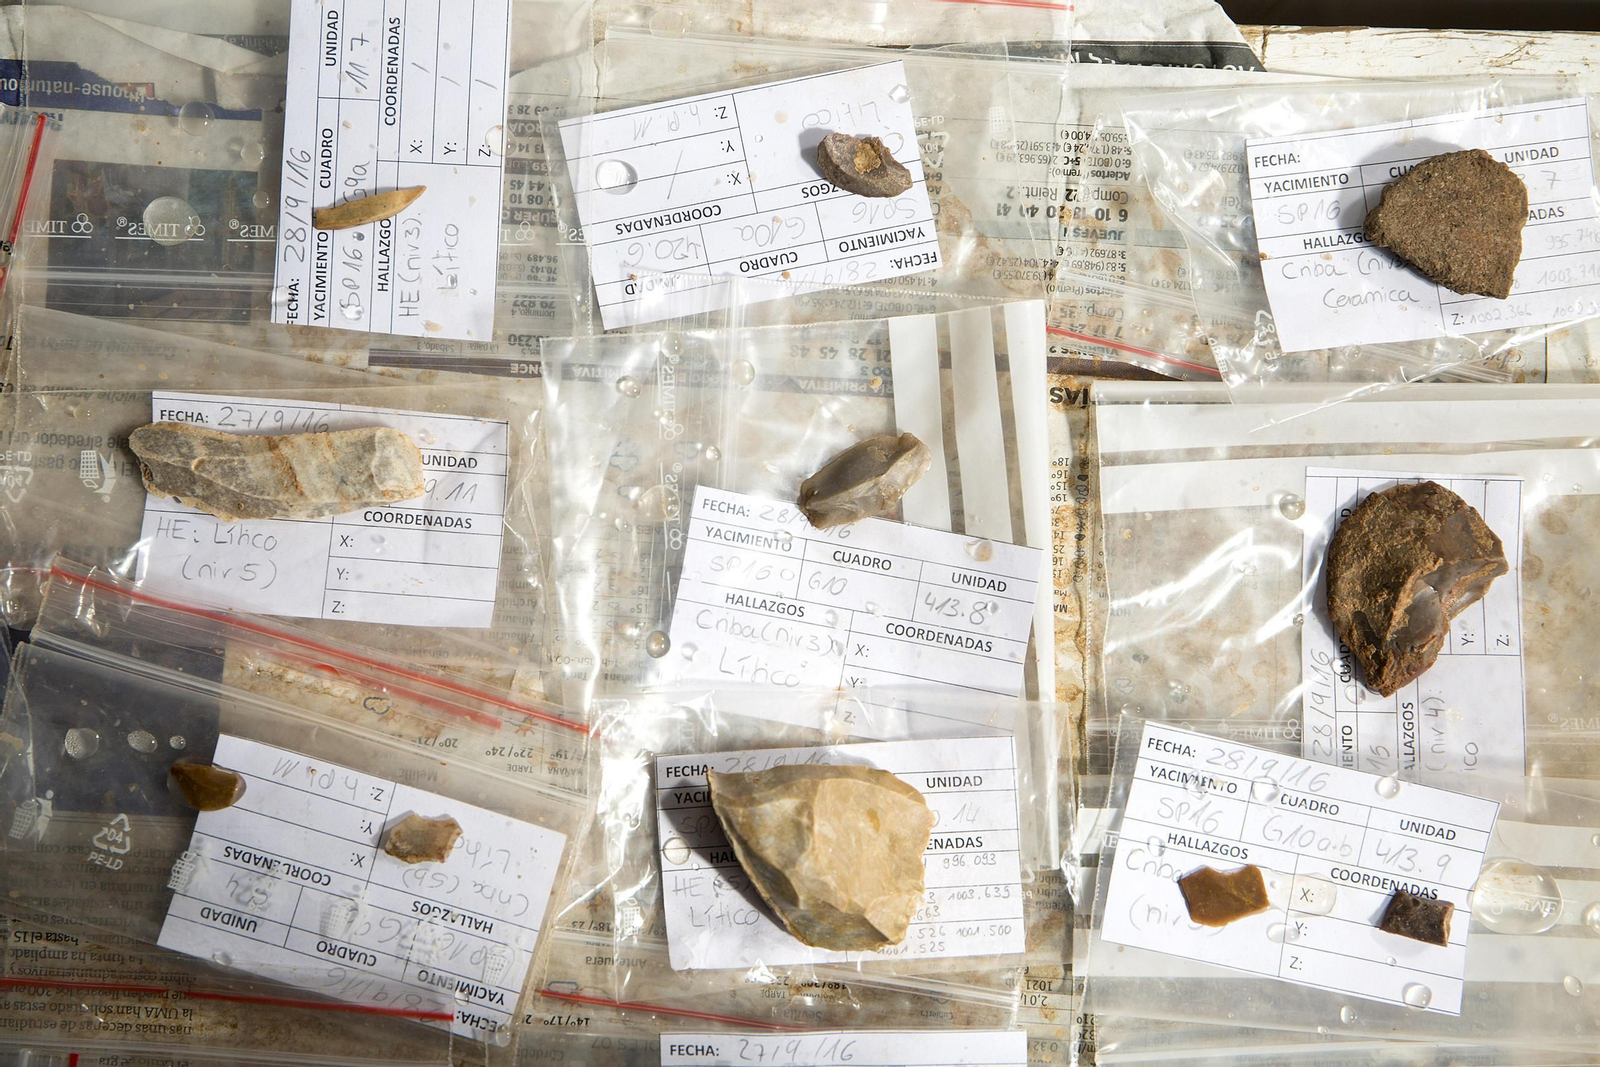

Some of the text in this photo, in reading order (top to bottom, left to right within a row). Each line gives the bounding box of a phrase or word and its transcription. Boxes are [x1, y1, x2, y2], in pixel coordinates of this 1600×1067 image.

[325, 10, 339, 67] UNIDAD
[384, 17, 400, 126] COORDENADAS
[714, 106, 728, 119] Z:
[410, 140, 423, 154] X:
[443, 142, 457, 155] Y:
[478, 144, 491, 157] Z:
[720, 140, 735, 153] Y:
[320, 128, 333, 189] CUADRO
[1254, 152, 1301, 169] FECHA:
[1504, 146, 1560, 164] UNIDAD
[726, 172, 742, 186] X:
[1090, 169, 1131, 181] Aciertos
[1388, 164, 1418, 179] CUA
[1263, 172, 1350, 194] YACIMIENTO
[526, 194, 544, 205] 08
[615, 205, 722, 235] COORDENADAS
[1094, 208, 1112, 222] 10
[1118, 209, 1129, 223] 6
[838, 226, 926, 254] YACIMIENTO
[1072, 227, 1125, 241] JUEVES
[527, 253, 559, 264] 96.489
[739, 251, 799, 273] CUADRO
[889, 251, 938, 269] FECHA:
[313, 231, 329, 321] YACIMIENTO
[520, 308, 556, 320] Domingo,
[1450, 312, 1465, 326] Z:
[159, 409, 209, 424] FECHA:
[34, 431, 103, 450] alrededor
[421, 454, 478, 469] UNIDAD
[702, 498, 751, 518] FECHA:
[363, 510, 473, 530] COORDENADAS
[339, 534, 354, 548] X:
[705, 525, 793, 553] YACIMIENTO
[832, 550, 892, 572] CUADRO
[336, 567, 350, 581] Y:
[951, 572, 1008, 593] UNIDAD
[331, 600, 346, 614] Z:
[725, 592, 806, 618] HALLAZGOS
[885, 622, 993, 653] COORDENADAS
[1461, 633, 1475, 646] Y:
[1496, 633, 1510, 647] Z:
[854, 643, 870, 658] X:
[850, 676, 864, 689] Y:
[843, 710, 857, 725] Z:
[1147, 737, 1197, 758] FECHA:
[666, 764, 715, 778] FECHA:
[925, 775, 983, 789] UNIDAD
[1149, 765, 1239, 794] YACIMIENTO
[370, 786, 385, 801] Z:
[1280, 793, 1340, 816] CUADRO
[360, 819, 373, 834] Y:
[1399, 819, 1456, 841] UNIDAD
[1167, 832, 1249, 860] HALLAZGOS
[87, 850, 124, 871] PE-LD
[350, 851, 366, 868] X:
[1330, 867, 1439, 901] COORDENADAS
[1299, 887, 1315, 903] X:
[200, 906, 259, 933] UNIDAD
[411, 900, 494, 935] HALLAZGOS
[1294, 921, 1308, 937] Y:
[13, 929, 79, 946] hasta el 15
[315, 940, 378, 967] CUADRO
[1289, 956, 1303, 971] Z:
[417, 969, 506, 1006] YACIMIENTO
[1025, 979, 1053, 992] 1021
[12, 1001, 47, 1014] estas
[116, 1005, 141, 1019] han
[143, 1006, 180, 1022] UMA
[182, 1007, 194, 1022] la
[60, 1020, 77, 1034] de
[454, 1010, 501, 1033] ECHA:
[135, 1023, 168, 1037] unas
[169, 1024, 193, 1037] nas
[669, 1045, 720, 1058] FECHA:
